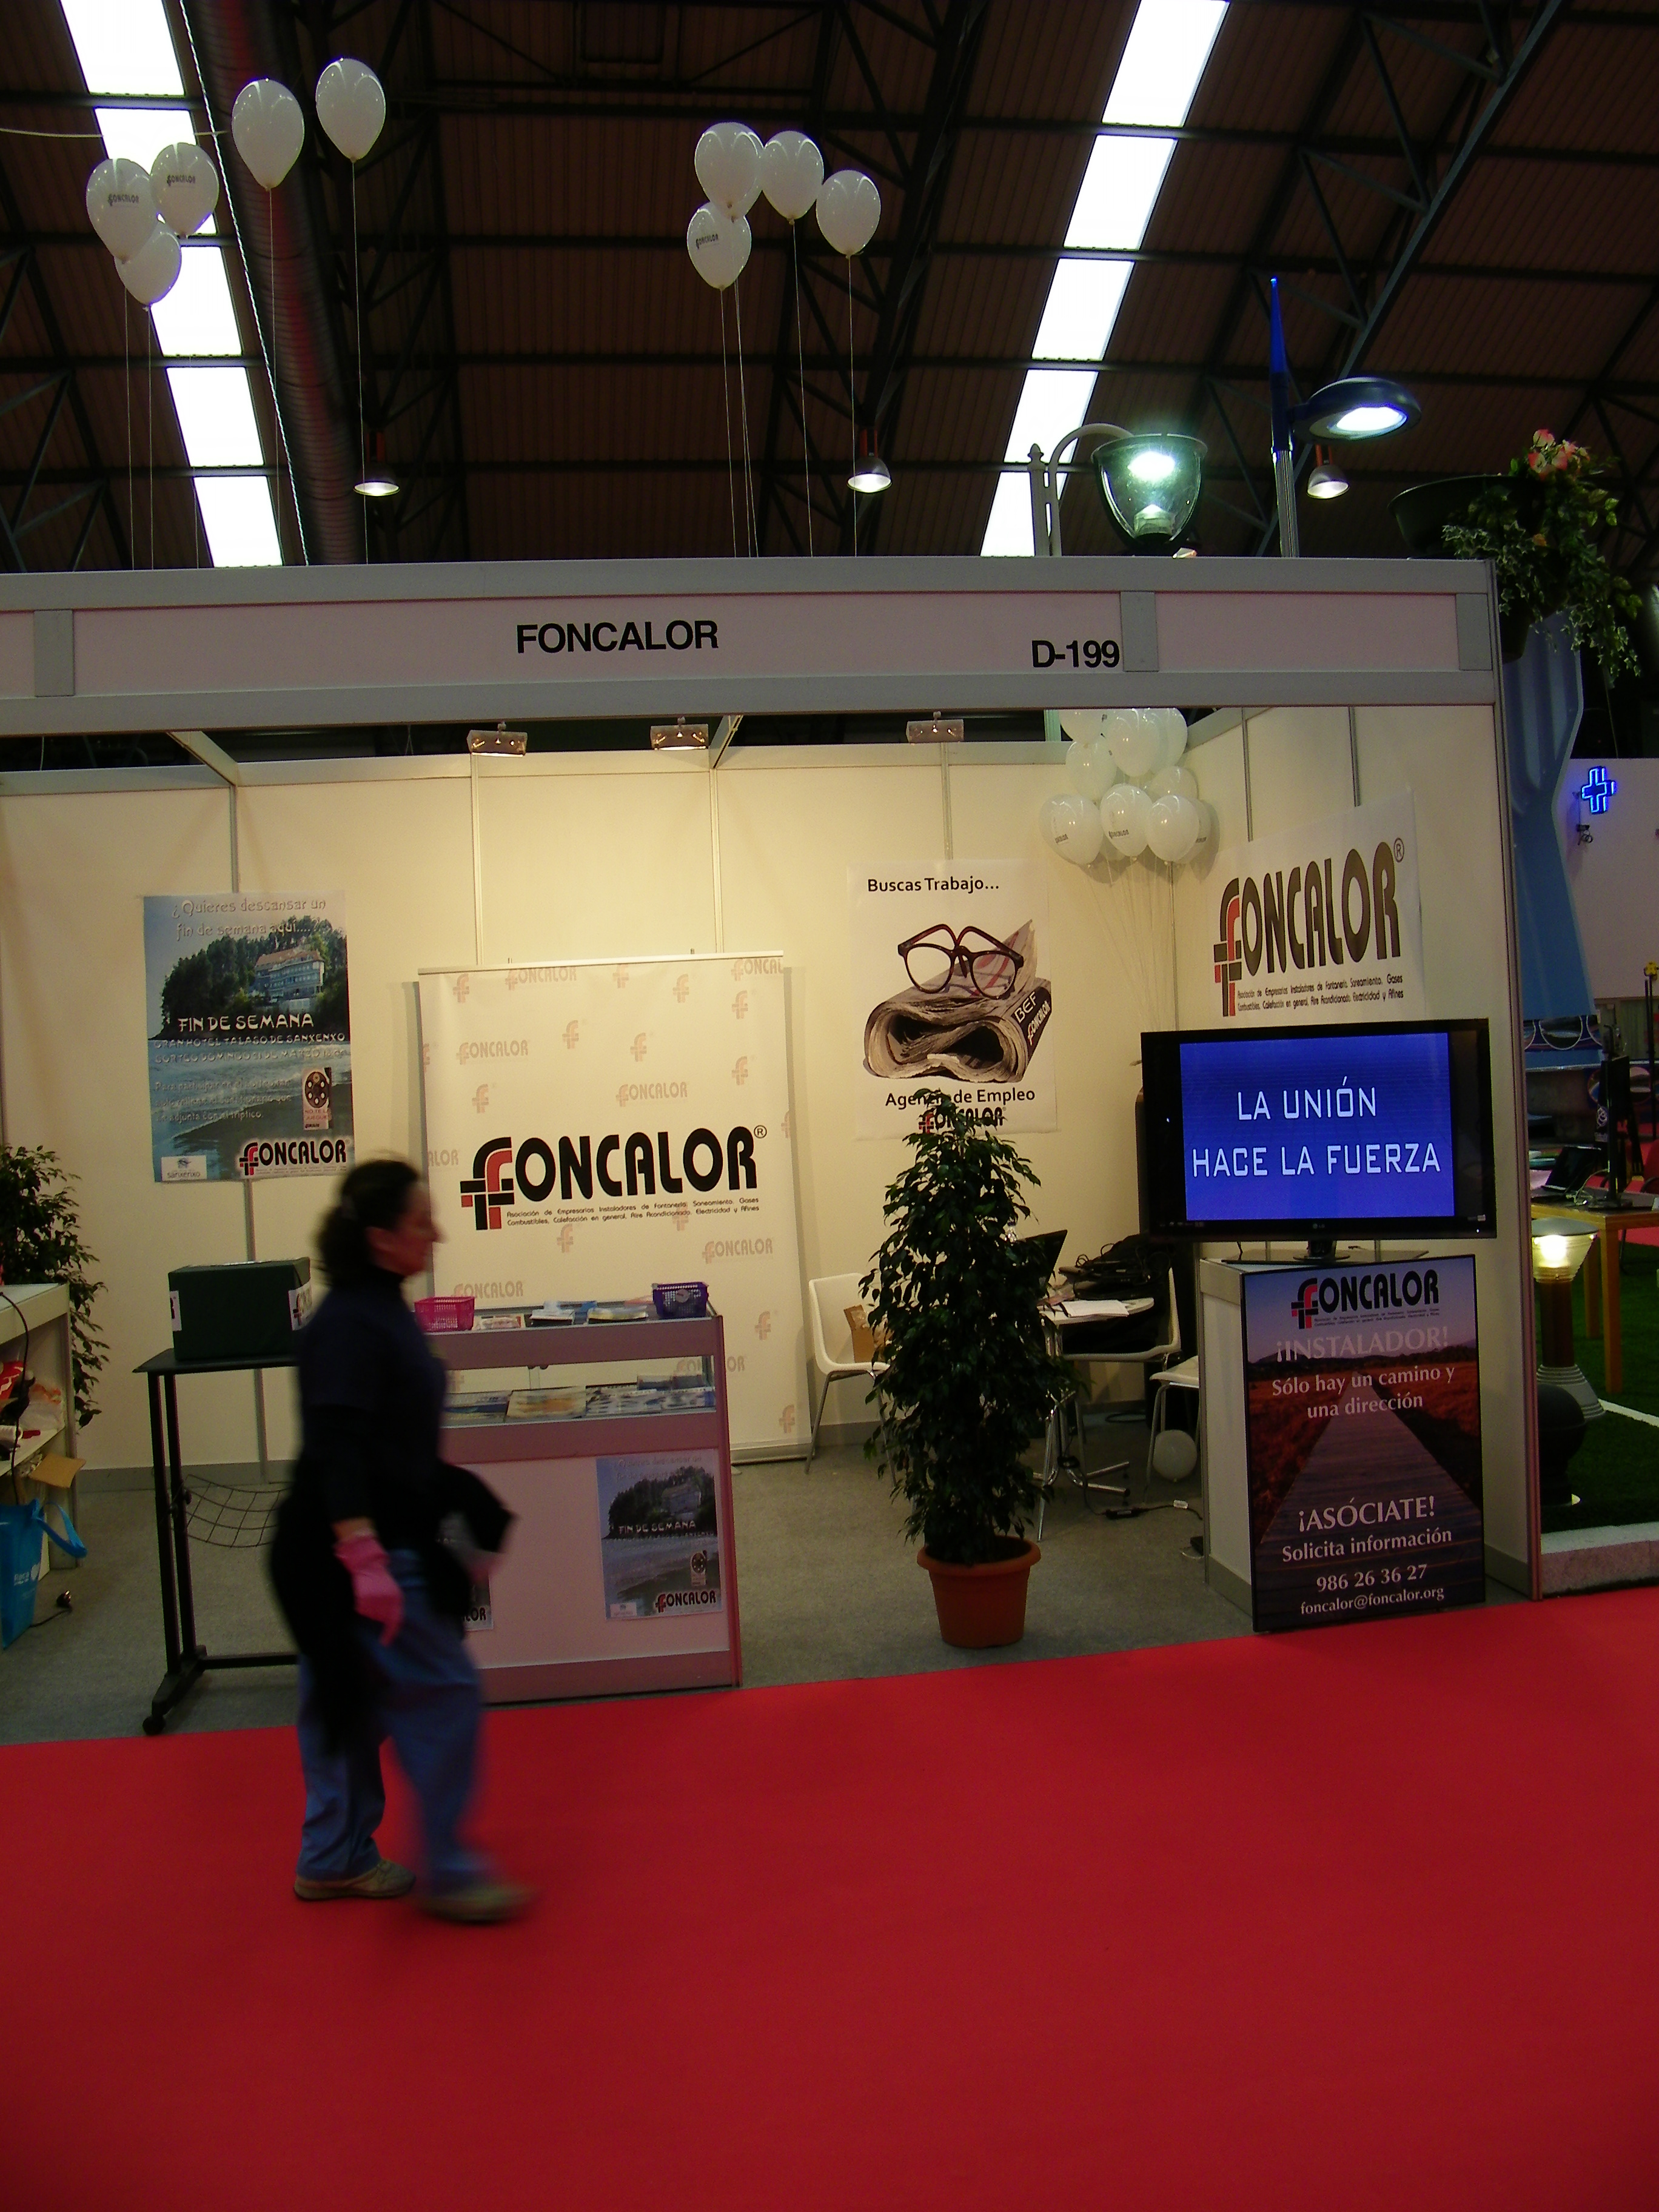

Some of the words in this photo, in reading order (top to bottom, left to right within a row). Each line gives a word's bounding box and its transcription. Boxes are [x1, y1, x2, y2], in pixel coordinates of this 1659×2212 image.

[517, 620, 719, 654] FONCALOR
[1031, 640, 1120, 668] D-199
[868, 879, 922, 892] Buscas
[924, 876, 999, 894] Trabajo...
[241, 897, 307, 912] descansar
[310, 900, 326, 910] un
[176, 922, 193, 940] fin
[198, 923, 213, 936] de
[217, 924, 267, 936] semana
[1213, 841, 1401, 1017] FONCALOR
[178, 1017, 204, 1033] FIN
[207, 1016, 231, 1031] DE
[235, 1012, 314, 1030] SEMANA
[154, 1038, 184, 1048] GRAN
[186, 1037, 221, 1047] HOTEL
[270, 1034, 284, 1044] DE
[286, 1033, 346, 1044] SANXENXO
[953, 1089, 972, 1104] de
[977, 1087, 1036, 1105] Empleo
[1237, 1091, 1271, 1121] LA
[1283, 1076, 1377, 1119] UNIÓN
[240, 1139, 347, 1175] FONCALOR
[1192, 1147, 1268, 1178] HACE
[1281, 1146, 1315, 1176] LA
[1327, 1142, 1441, 1175] FUERZA
[460, 1126, 757, 1230] FONCALOR
[507, 1210, 540, 1218] Asociación
[557, 1207, 594, 1216] Empresarios
[599, 1204, 636, 1213] Instaladores
[553, 1215, 588, 1224] Calefacción
[695, 1207, 731, 1215] Electricidad
[1291, 1269, 1440, 1330] FONCALOR
[1276, 1326, 1449, 1362] ¡INSTALADOR!
[1273, 1376, 1310, 1396] Sólo
[1316, 1372, 1346, 1395] hay
[1351, 1374, 1373, 1387] un
[1378, 1366, 1441, 1385] camino
[1446, 1366, 1455, 1384] y
[1307, 1403, 1339, 1419] una
[1344, 1392, 1424, 1415] dirección
[651, 1520, 696, 1532] SEMANA
[1299, 1495, 1435, 1532] ¡ASÓCIATE!
[1282, 1540, 1345, 1563] Solicita
[1350, 1527, 1452, 1554] información
[1316, 1574, 1349, 1593] 986
[1354, 1570, 1375, 1588] 26
[1381, 1567, 1401, 1584] 36
[1407, 1564, 1428, 1581] 27
[655, 1589, 716, 1613] FONCALOR
[1301, 1586, 1445, 1615] foncalor@foncalor.org
